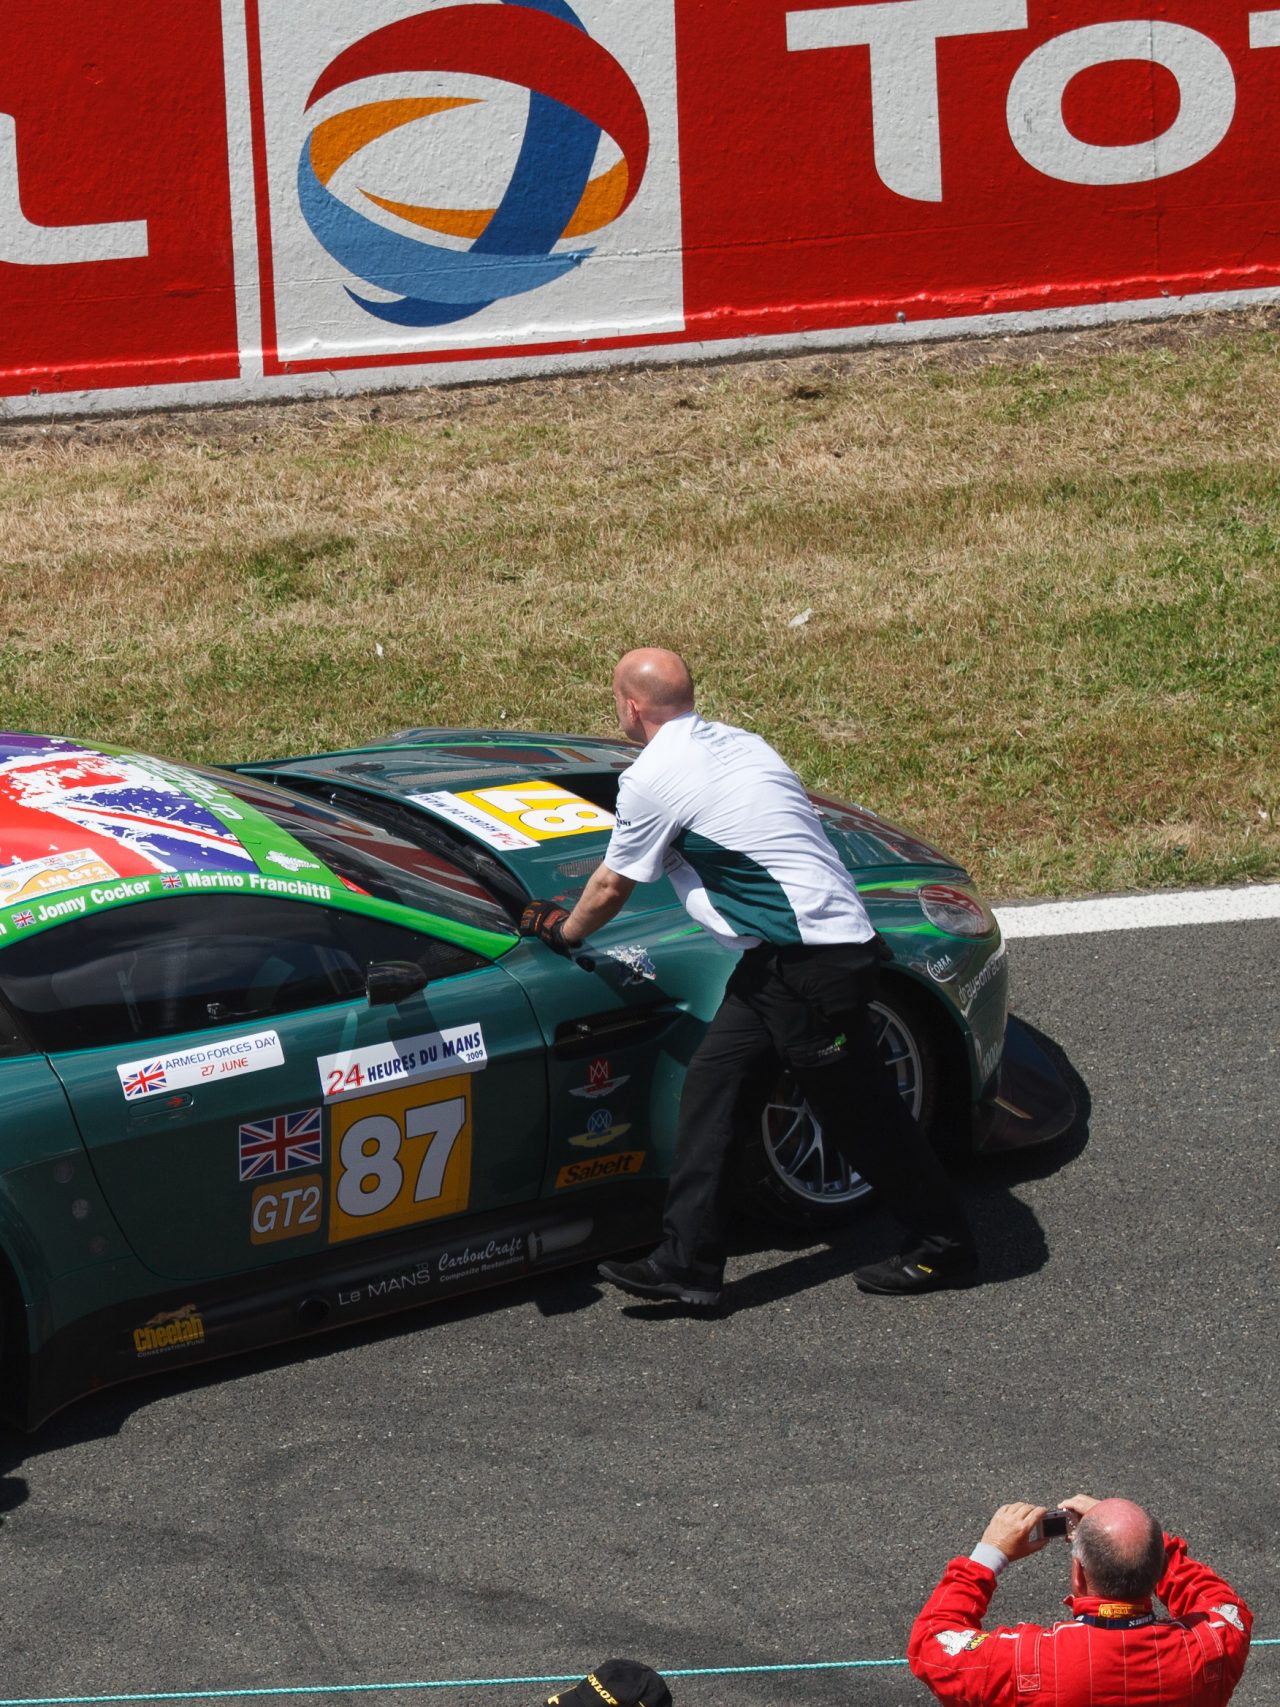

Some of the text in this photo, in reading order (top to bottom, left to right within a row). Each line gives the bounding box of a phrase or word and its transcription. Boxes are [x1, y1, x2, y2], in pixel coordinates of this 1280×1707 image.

[472, 789, 615, 832] 87
[37, 895, 87, 923] Jonny
[90, 879, 151, 905] Cocker
[184, 871, 332, 900] Marino Franchitti
[930, 954, 953, 977] COBRA
[165, 1035, 277, 1070] ARMED FORCES DAY
[201, 1057, 248, 1077] 27 JUNE
[327, 1032, 481, 1096] 24 HEURES DU MANS
[465, 1049, 484, 1062] 2009
[336, 1095, 467, 1218] 87
[563, 1154, 635, 1185] Sabelt
[252, 1185, 321, 1234] GT2
[438, 1237, 523, 1272] CarbonCraft
[439, 1255, 525, 1283] Composite Restoration
[338, 1291, 361, 1306] Le
[367, 1269, 431, 1299] MANS
[133, 1315, 205, 1353] Cheetah
